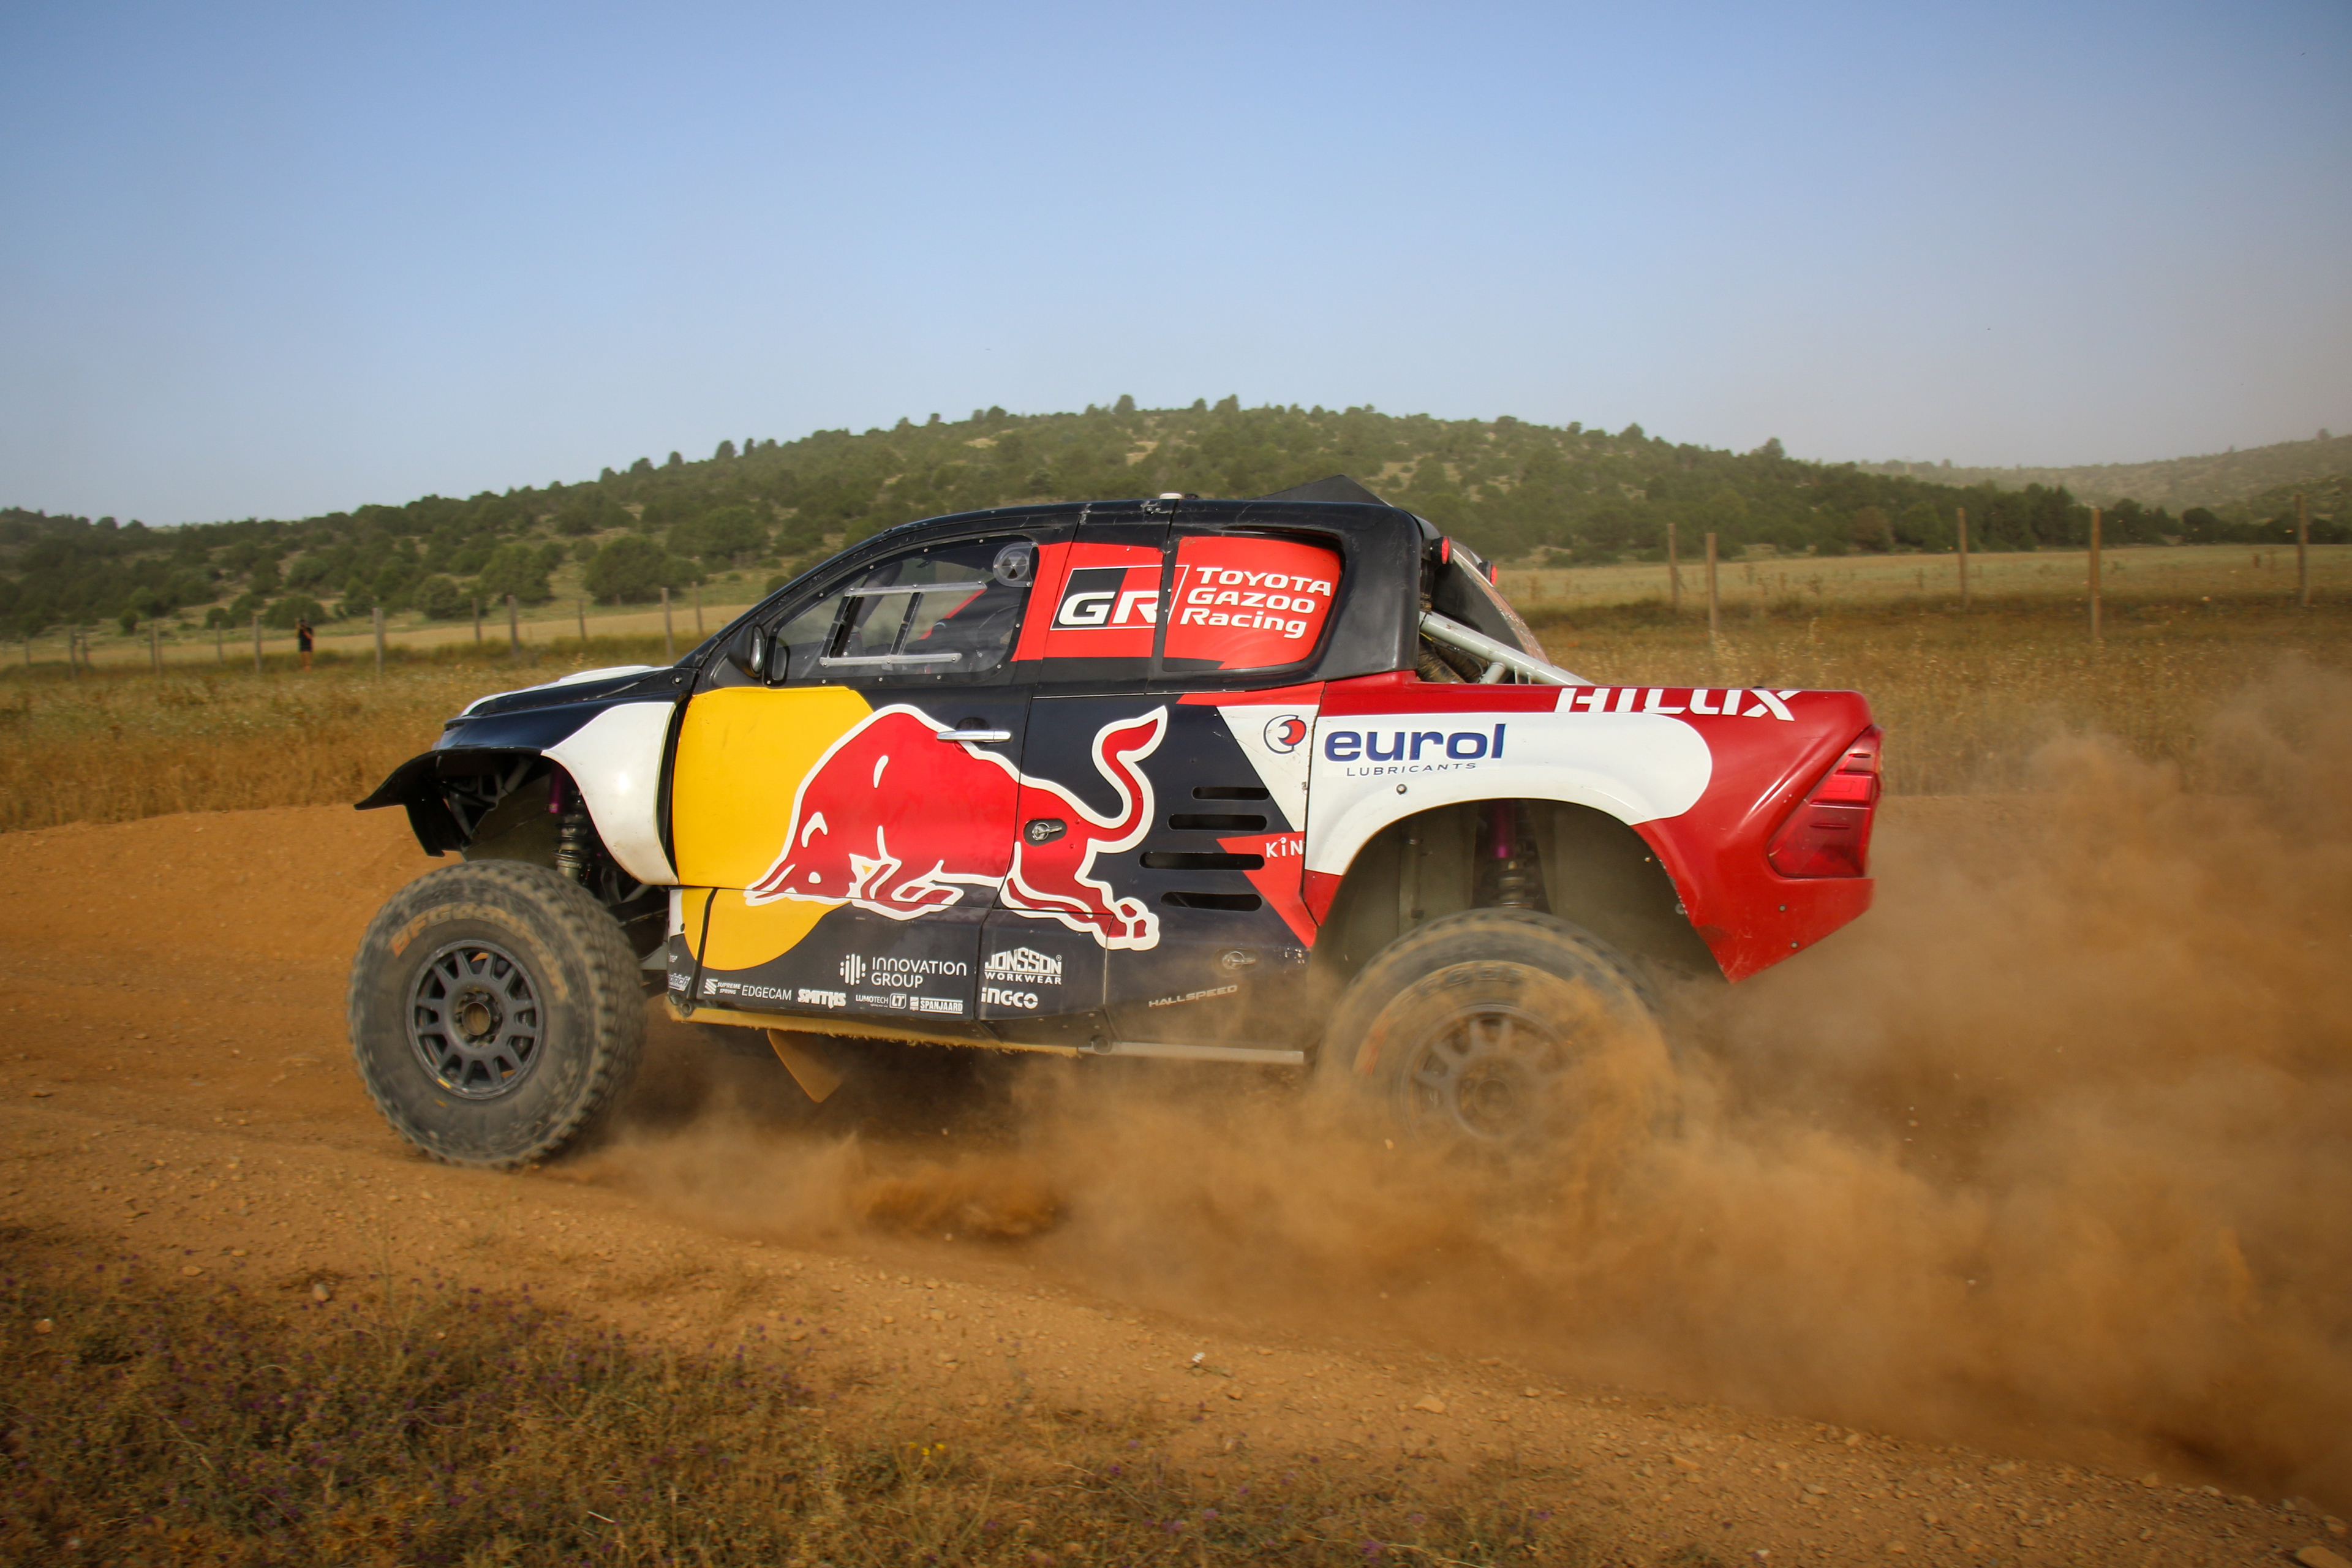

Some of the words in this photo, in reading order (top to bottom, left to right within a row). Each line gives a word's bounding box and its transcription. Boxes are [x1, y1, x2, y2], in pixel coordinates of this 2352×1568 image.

[1196, 567, 1331, 597] TOYOTA
[1058, 590, 1159, 625] GR
[1187, 588, 1315, 613] GAZOO
[1180, 608, 1307, 639] Racing
[1554, 688, 1801, 721] HILUX
[1324, 723, 1506, 762] eurol
[1346, 763, 1477, 777] LUBRICANTS
[872, 957, 967, 976] INNOVATION
[984, 947, 1061, 974] JONSSON
[871, 972, 924, 988] GROUP
[984, 971, 1061, 985] WORKWEAR
[741, 985, 791, 1001] EDGECAM
[797, 989, 846, 1009] SMITHS
[856, 995, 888, 1004] LUMOTECH
[1148, 985, 1237, 1007] HALLSPEED
[920, 1000, 963, 1011] SPANJAARD
